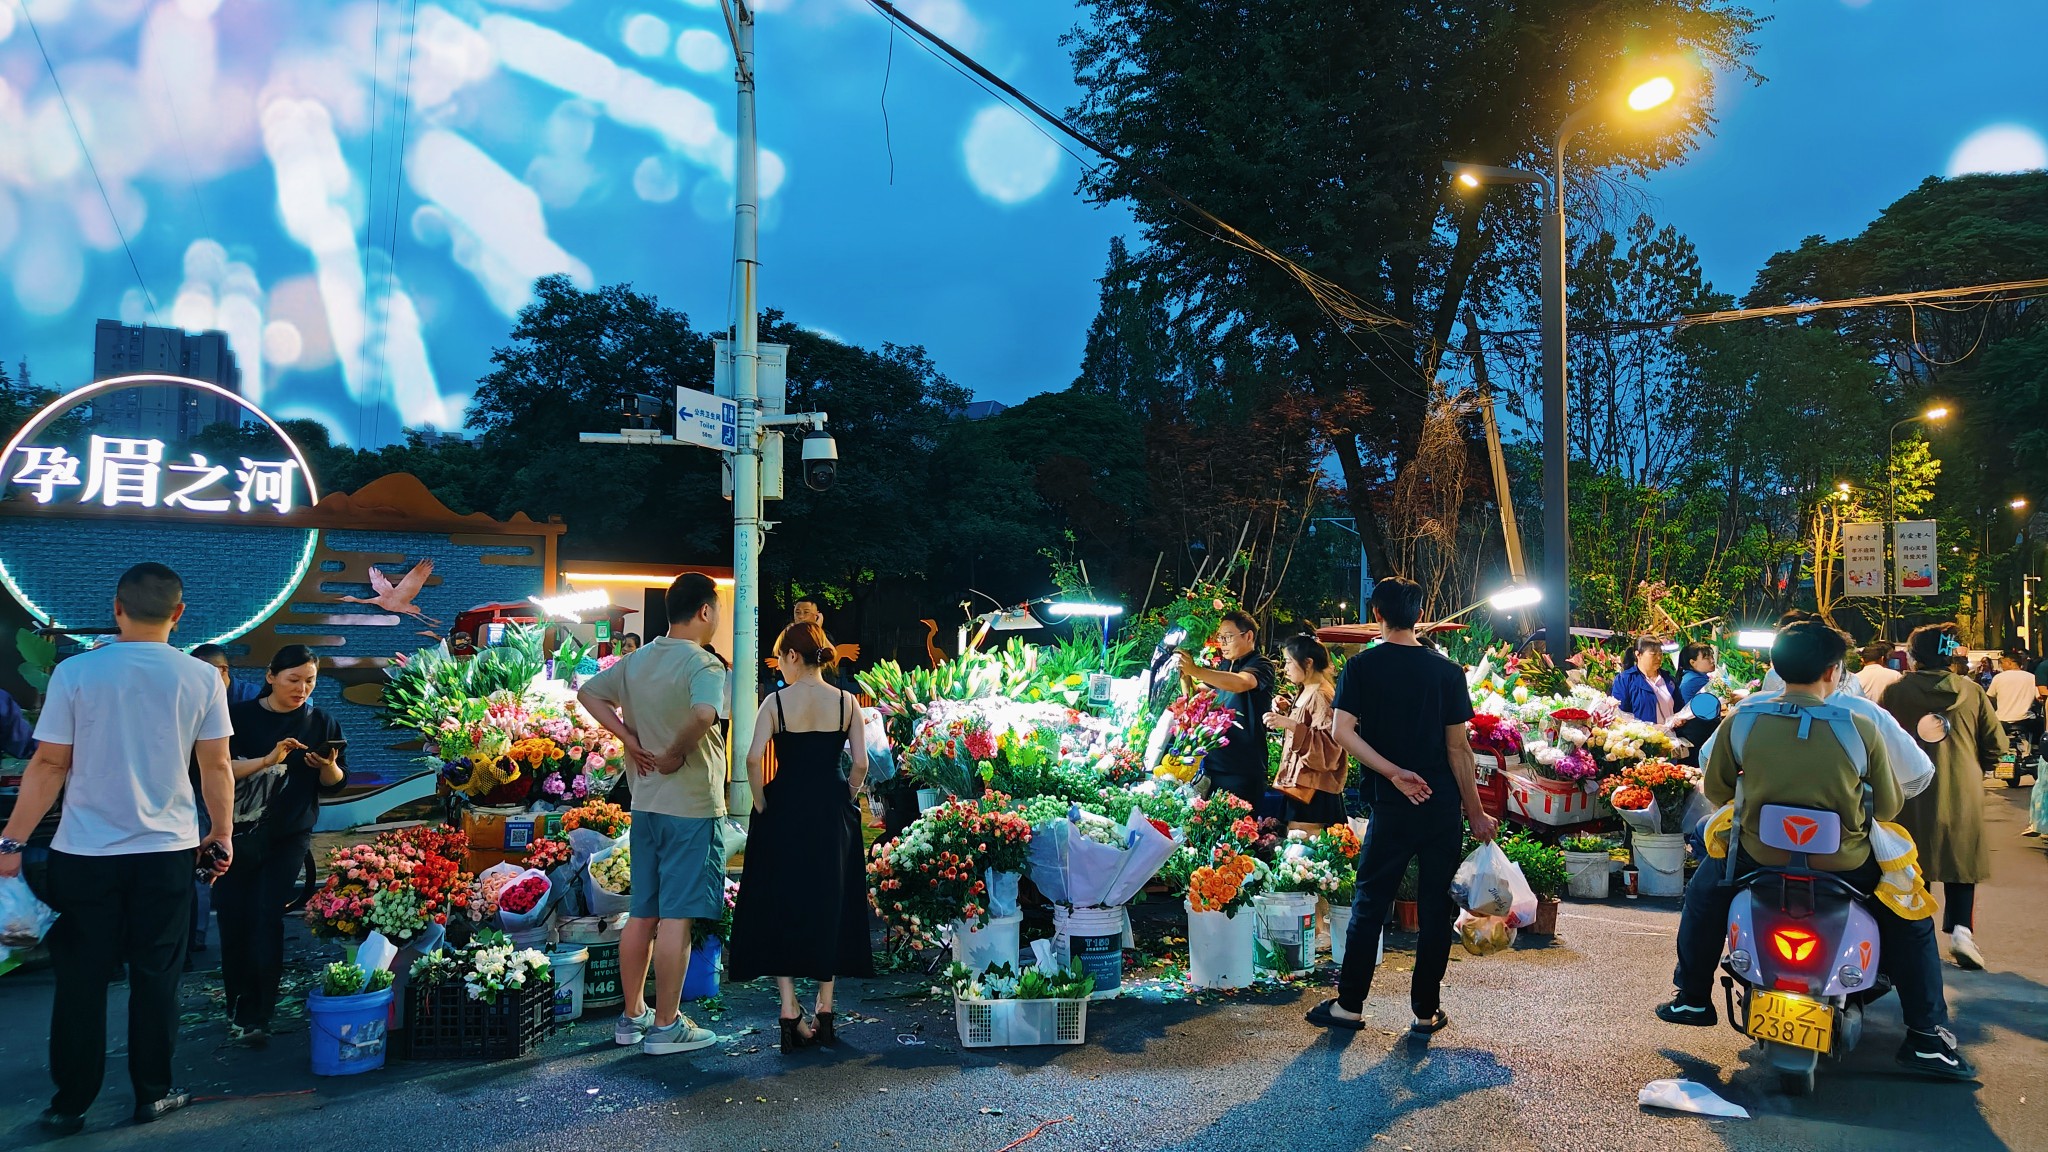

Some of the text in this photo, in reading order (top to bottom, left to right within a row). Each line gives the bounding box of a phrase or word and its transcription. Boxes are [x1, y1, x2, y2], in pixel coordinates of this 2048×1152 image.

[699, 420, 715, 430] Toilet
[11, 434, 301, 514] 孕眉之河
[1752, 1014, 1826, 1049] 2387T
